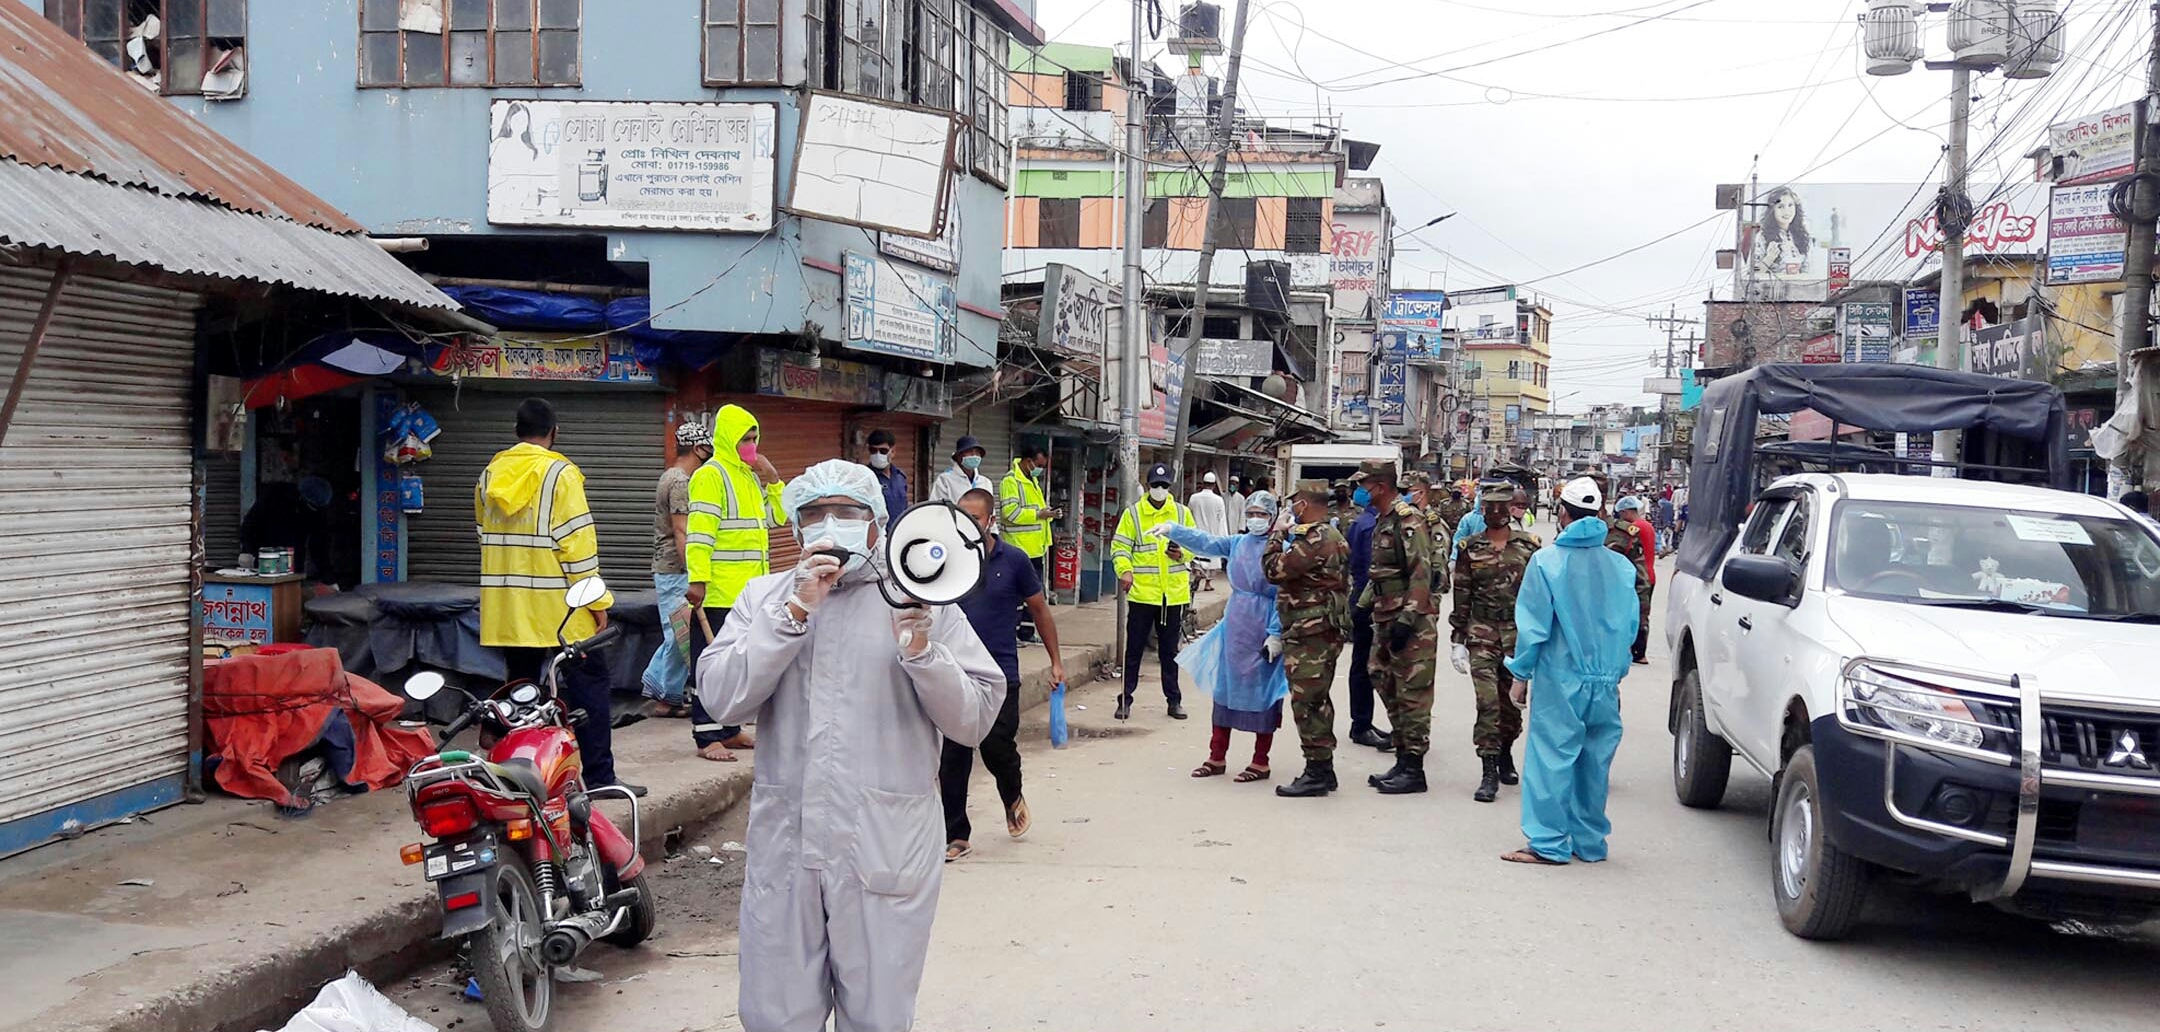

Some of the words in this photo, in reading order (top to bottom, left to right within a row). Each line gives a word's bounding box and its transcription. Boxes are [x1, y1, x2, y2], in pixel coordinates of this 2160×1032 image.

[564, 114, 607, 143] সোমা
[612, 108, 665, 144] সেলাই
[669, 110, 721, 143] মেশিন
[2066, 121, 2098, 143] হোমিও
[2102, 113, 2131, 133] মিশন
[620, 149, 646, 160] প্রোঃ
[651, 147, 690, 160] নিখিল
[695, 150, 742, 160] দেবনাথ
[667, 161, 730, 171] 01719-159986
[615, 173, 643, 182] এখানে
[646, 174, 678, 184] পুরাতন
[680, 173, 711, 184] সেলাই
[713, 173, 742, 185] মেশিন
[639, 187, 674, 196] মেরামত
[678, 187, 695, 196] করা
[1338, 260, 1374, 276] চানাচুর
